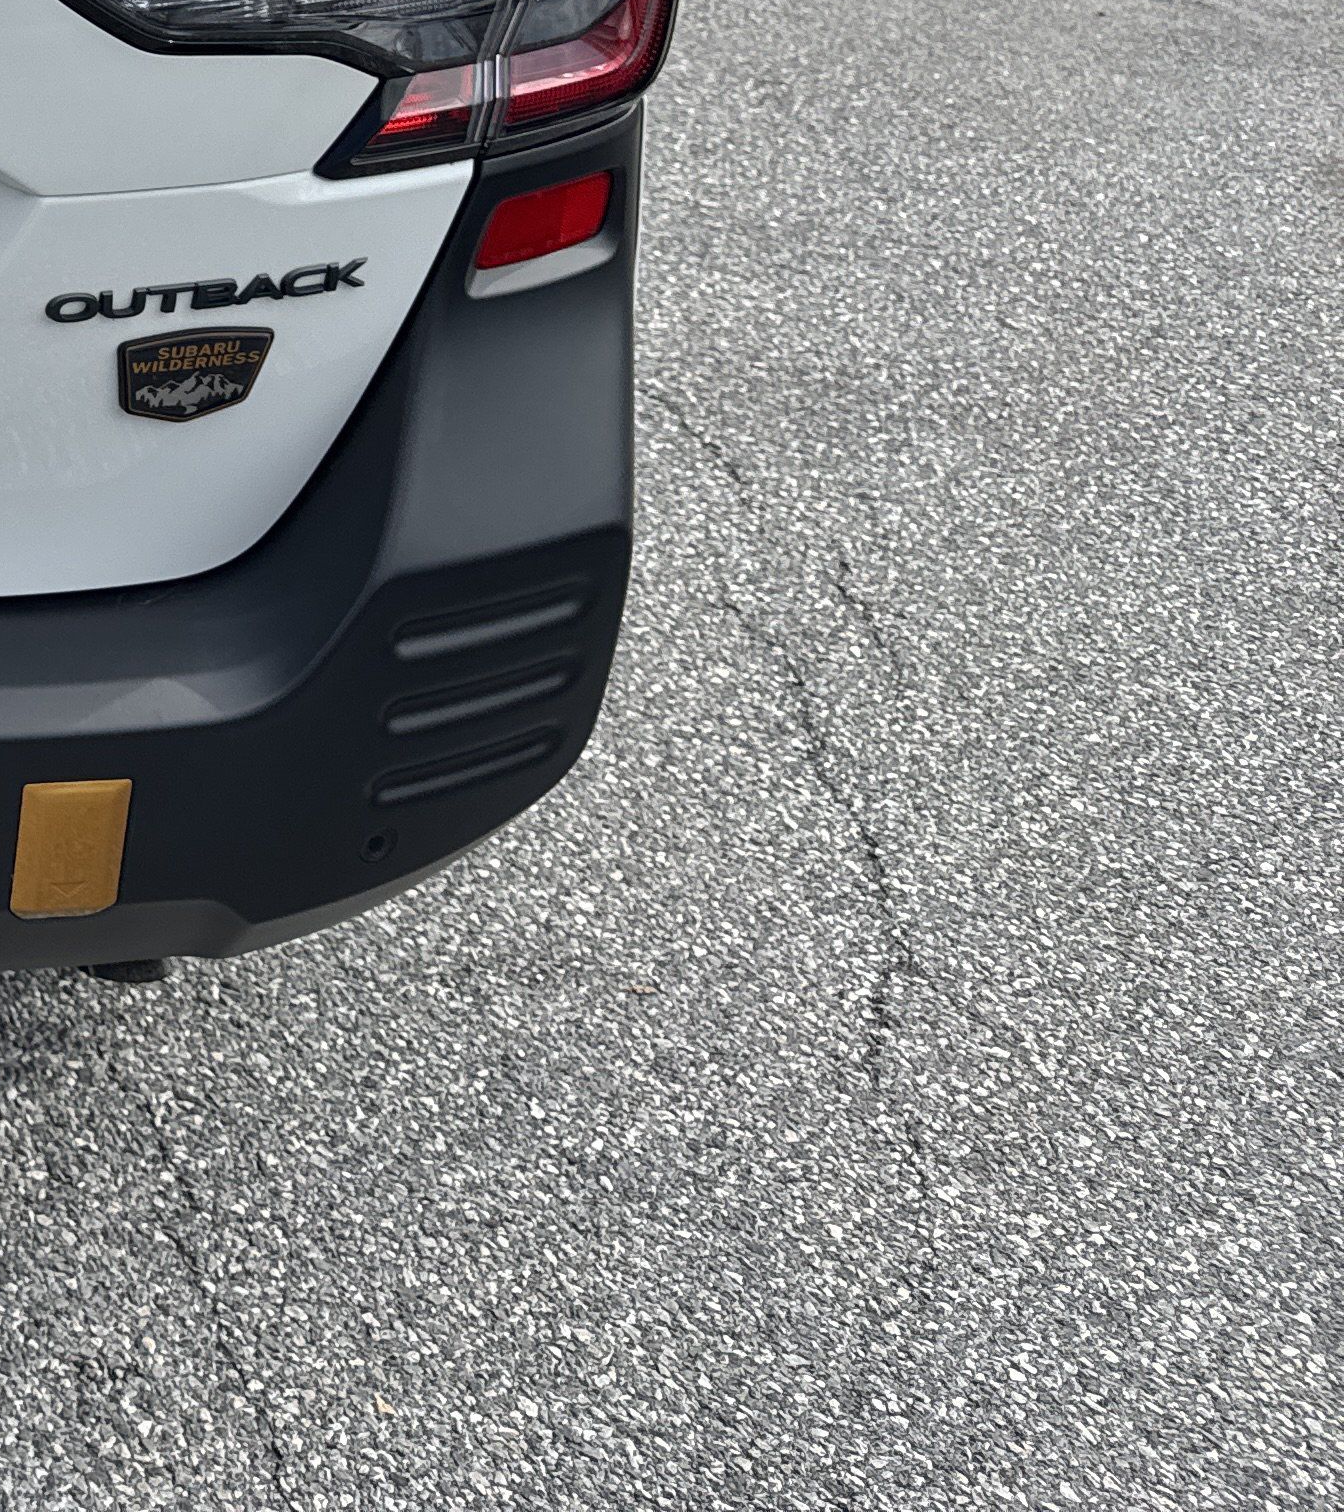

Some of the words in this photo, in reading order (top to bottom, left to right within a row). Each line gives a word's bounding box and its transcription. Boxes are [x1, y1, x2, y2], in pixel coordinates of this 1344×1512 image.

[44, 257, 369, 323] OUTBACK
[132, 350, 261, 374] WILDERNESS
[158, 340, 240, 360] SUBARU
